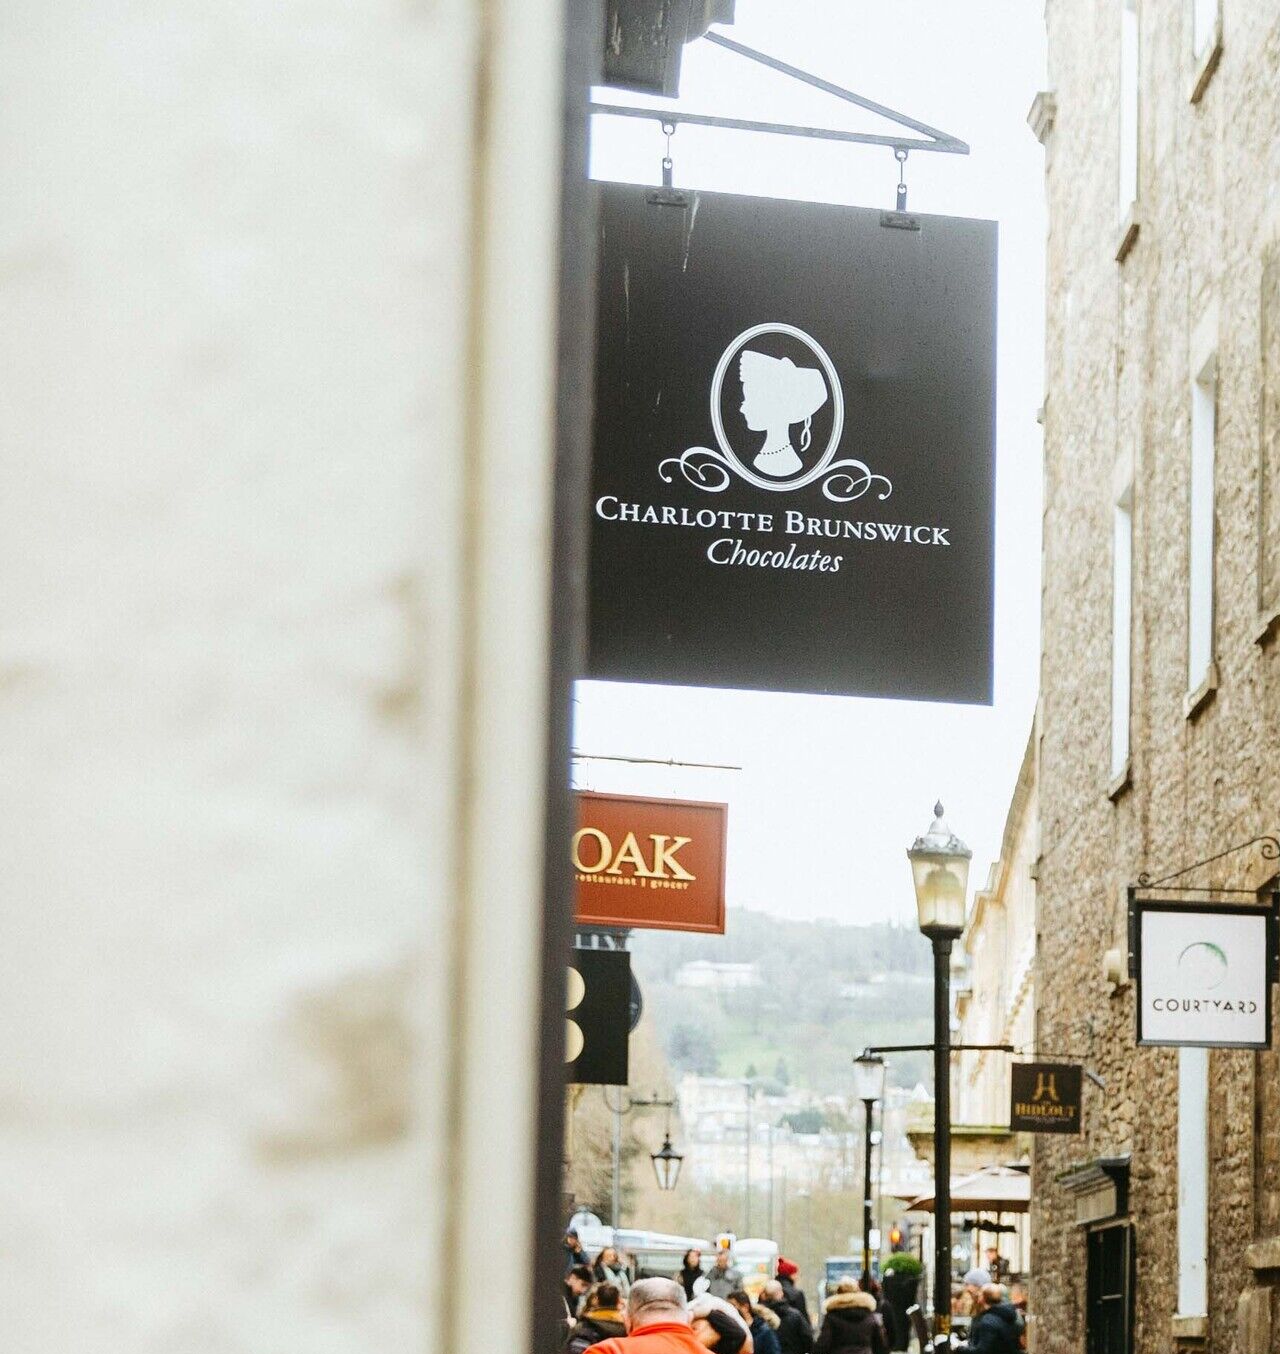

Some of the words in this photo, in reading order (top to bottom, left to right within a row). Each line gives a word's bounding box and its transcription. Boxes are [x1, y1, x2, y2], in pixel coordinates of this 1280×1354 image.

[595, 495, 773, 532] CHARLOTTE
[785, 510, 951, 546] BRUNSWICK
[706, 538, 843, 573] Chocolates
[571, 827, 696, 880] OAK
[1152, 998, 1257, 1014] COURTYARD
